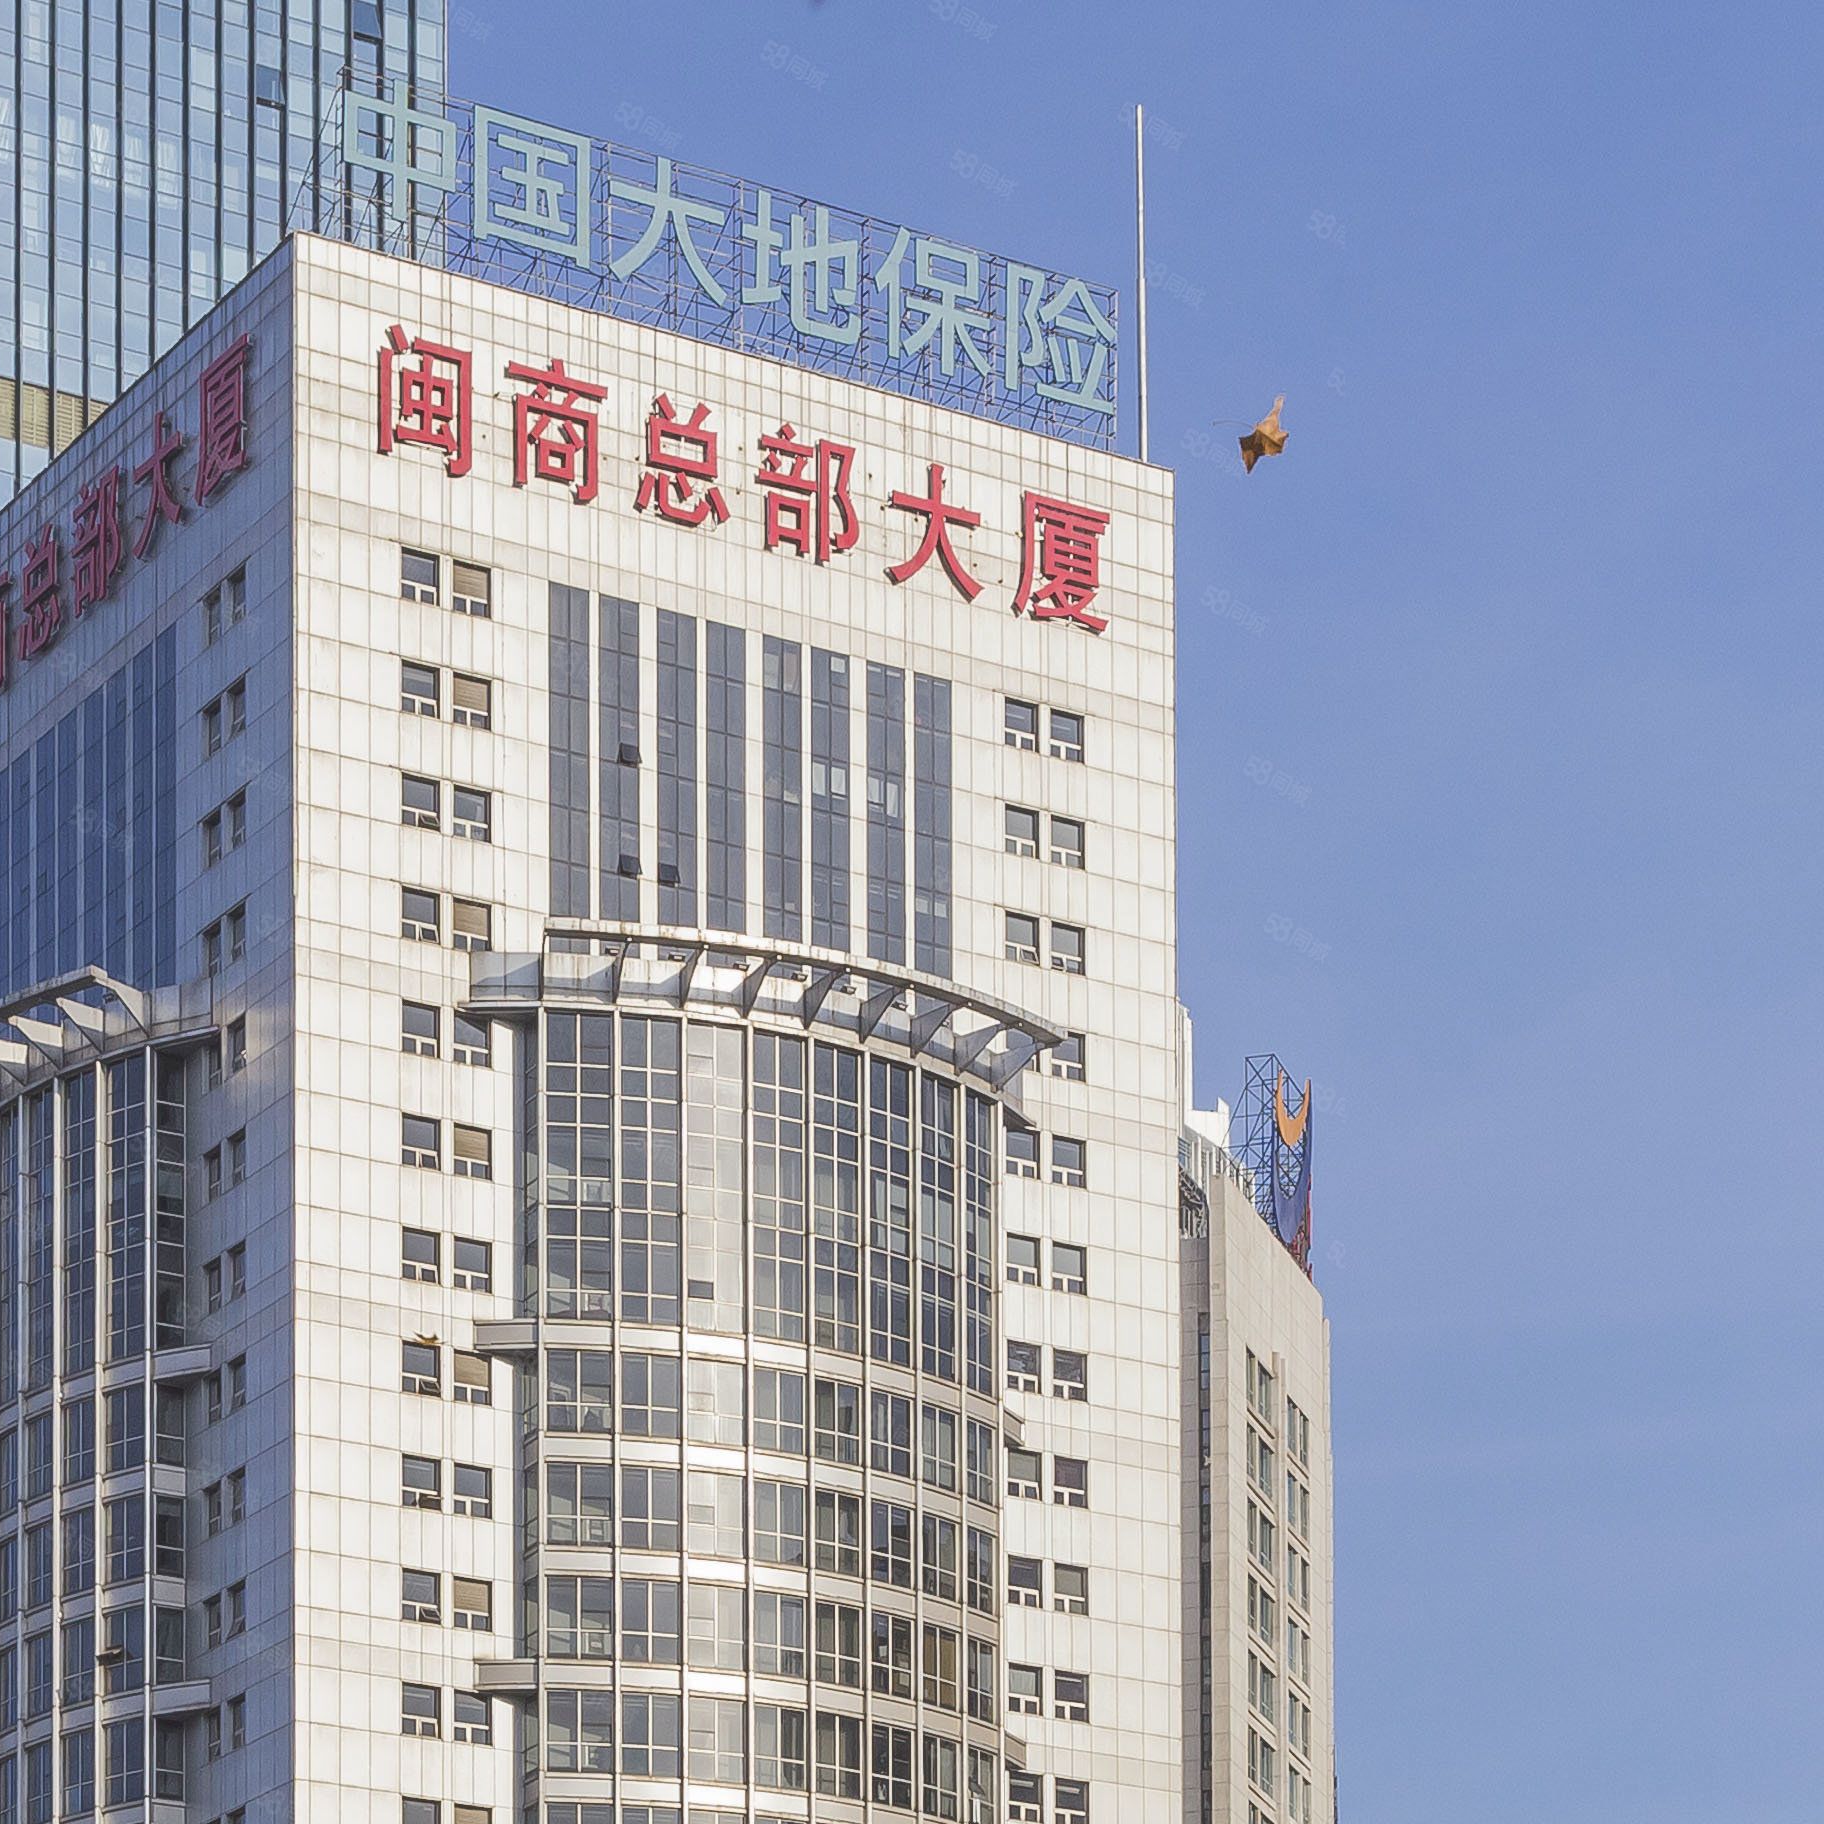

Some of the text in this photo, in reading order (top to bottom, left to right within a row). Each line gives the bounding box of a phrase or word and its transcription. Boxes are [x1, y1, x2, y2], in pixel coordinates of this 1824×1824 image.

[342, 78, 1117, 416] 中国大地保险
[376, 324, 1111, 634] 闽商总部大厦
